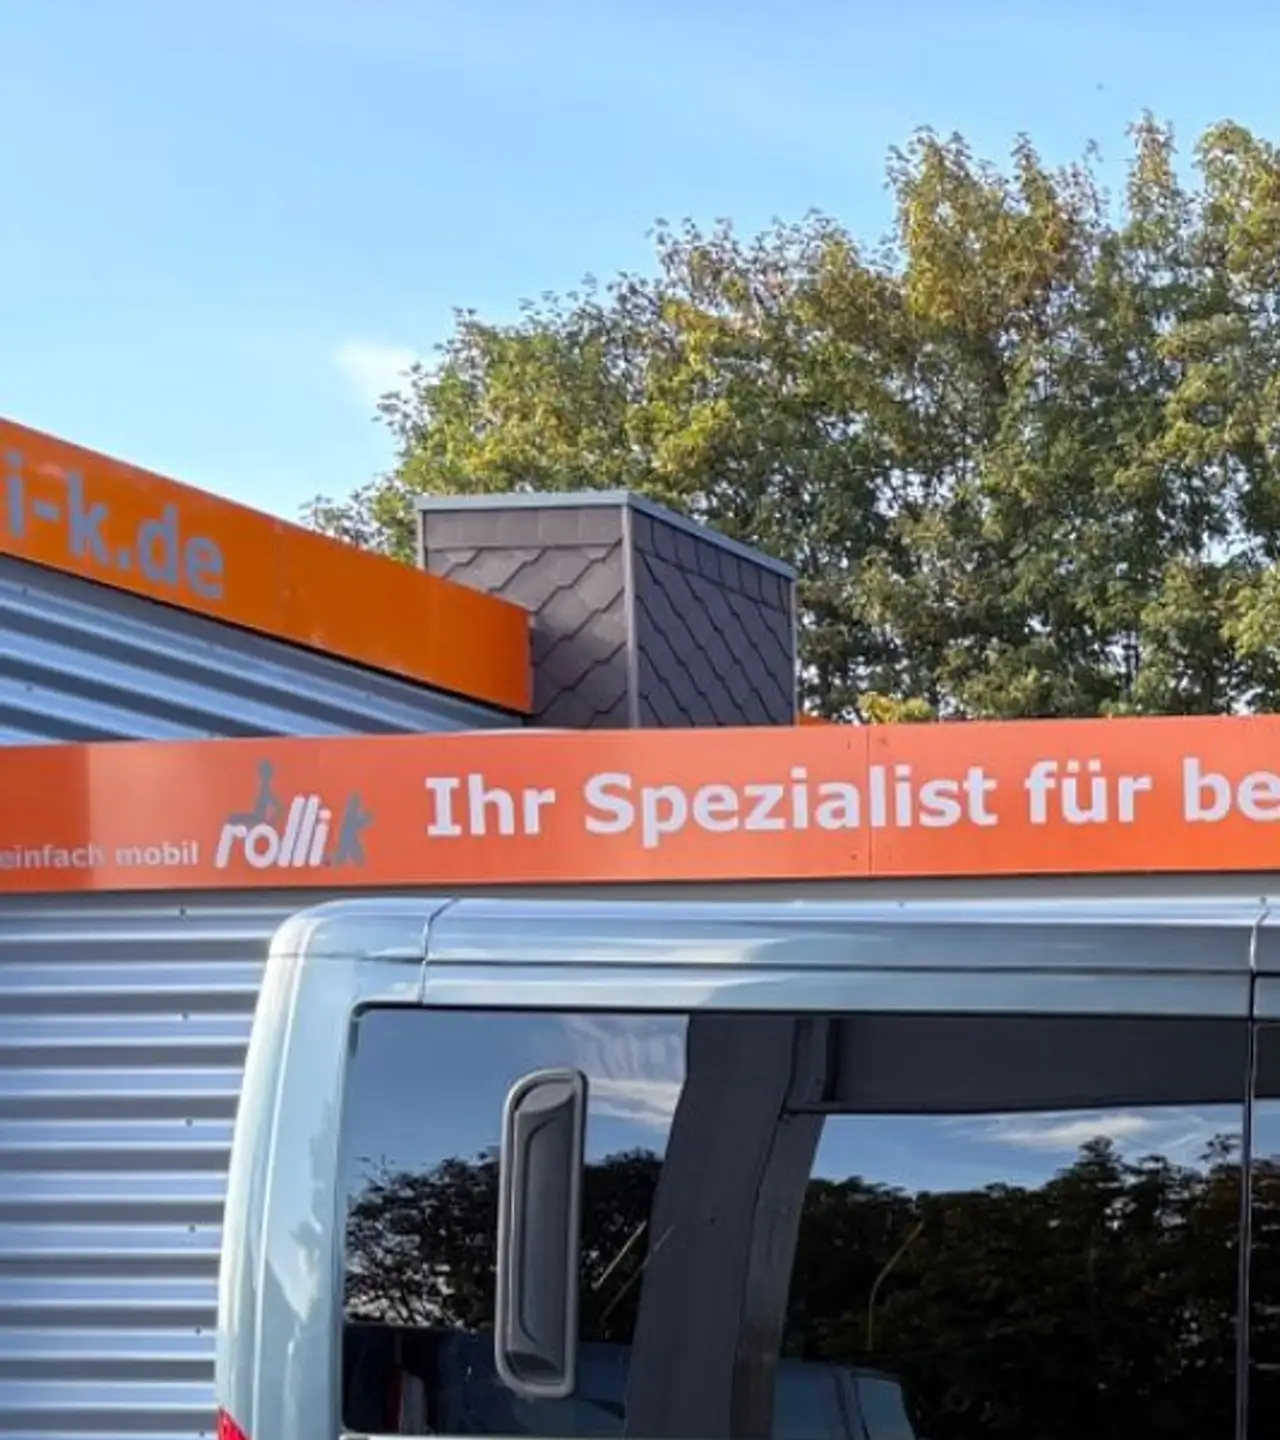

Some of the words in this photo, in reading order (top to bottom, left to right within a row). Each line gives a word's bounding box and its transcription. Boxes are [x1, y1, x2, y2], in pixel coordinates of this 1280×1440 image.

[425, 774, 555, 837] Ihr
[584, 765, 998, 848] Spezialist
[1025, 760, 1153, 824] für
[0, 844, 105, 870] einfach
[116, 840, 199, 867] mobil
